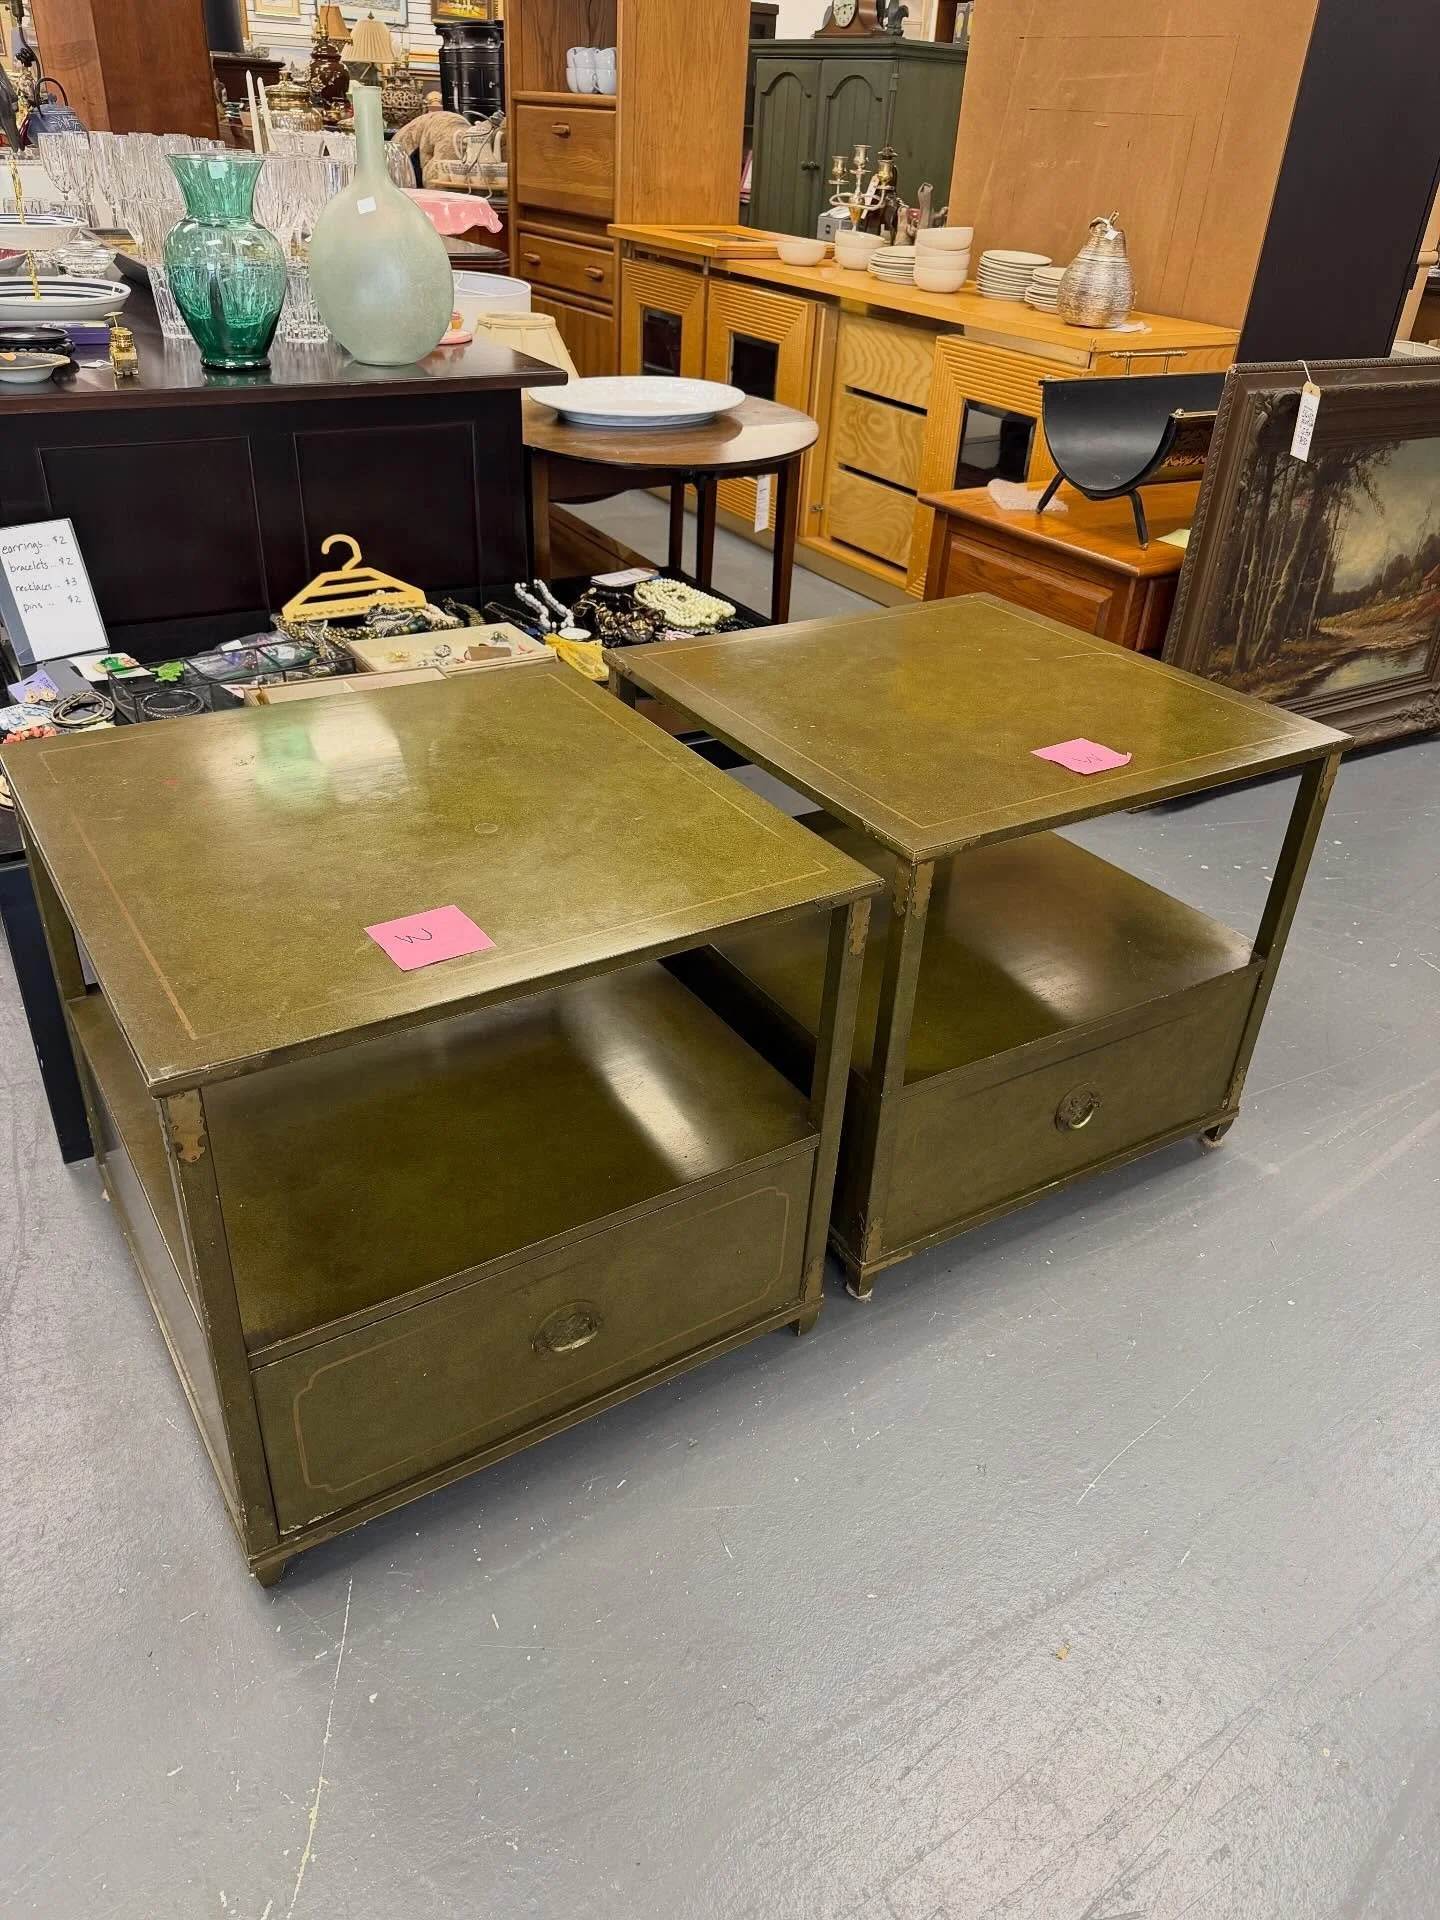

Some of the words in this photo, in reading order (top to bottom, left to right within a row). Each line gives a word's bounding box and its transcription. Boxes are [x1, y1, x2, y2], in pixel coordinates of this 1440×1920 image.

[52, 535, 67, 545] $2
[59, 556, 73, 566] $2
[65, 577, 77, 586] $3
[67, 594, 81, 603] $2
